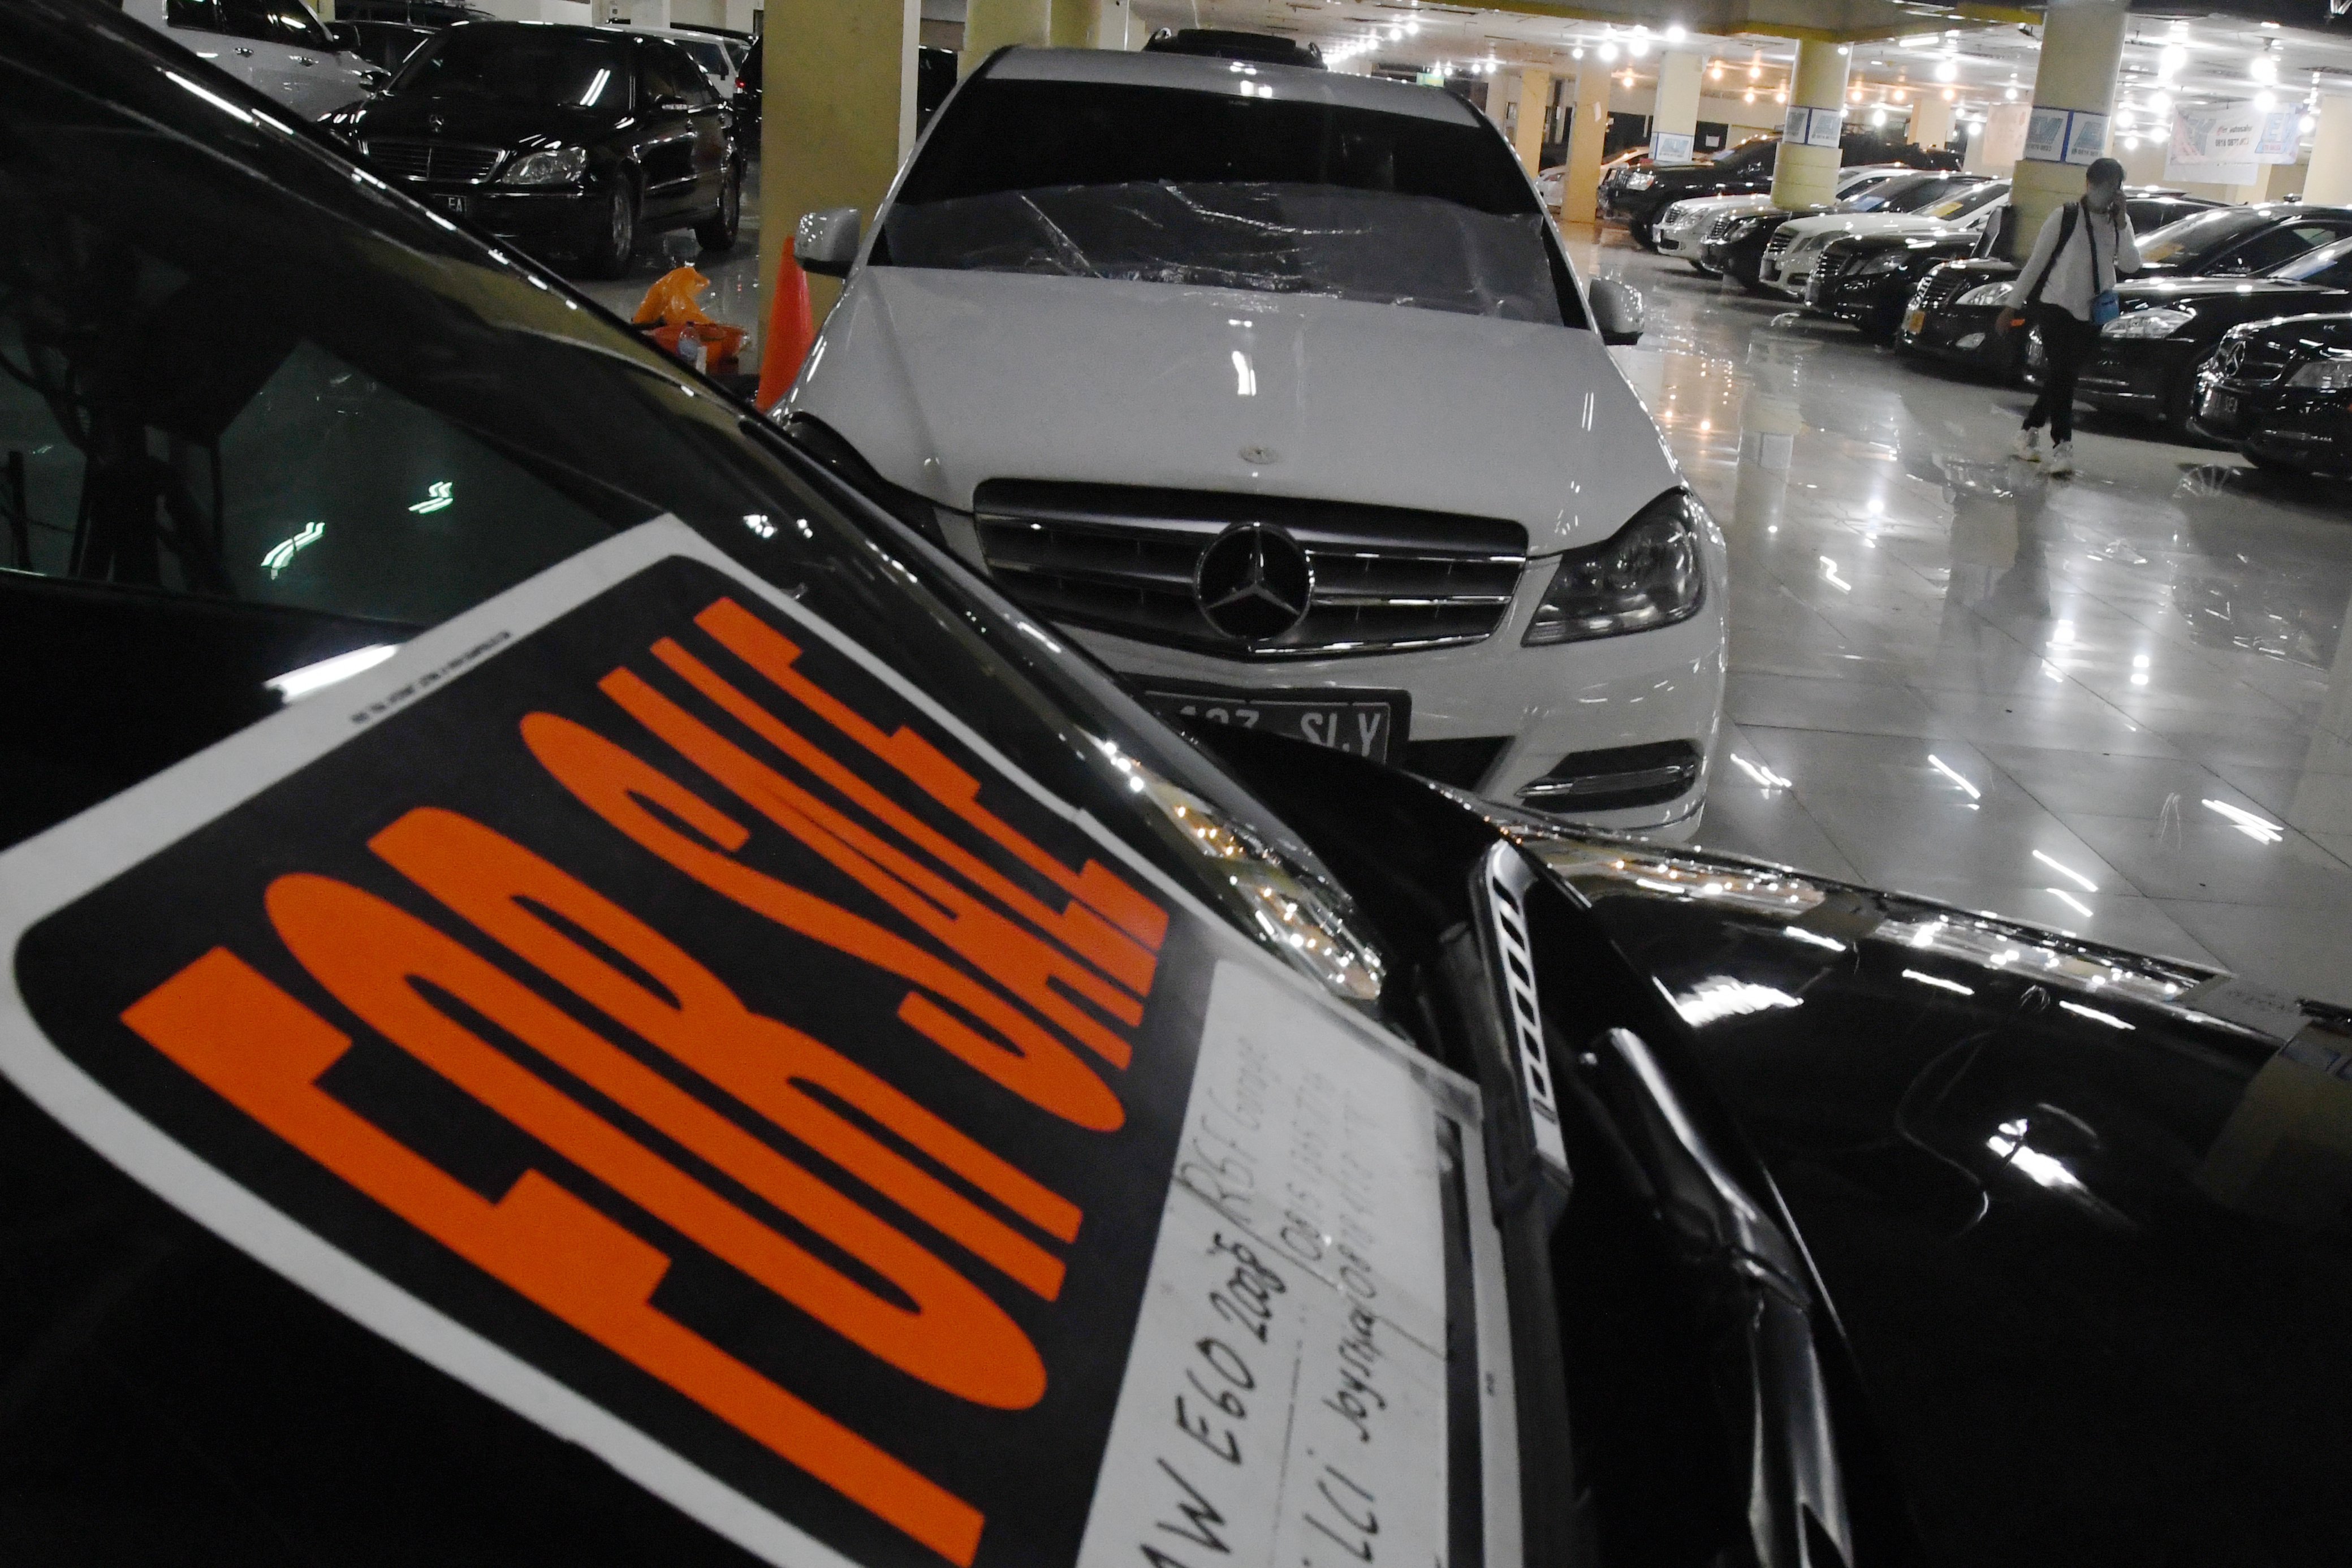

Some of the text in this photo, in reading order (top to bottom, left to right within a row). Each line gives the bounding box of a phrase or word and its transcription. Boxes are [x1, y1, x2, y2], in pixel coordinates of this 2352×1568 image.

[122, 598, 1168, 1567] FOR SALE
[1173, 1333, 1254, 1466] E60
